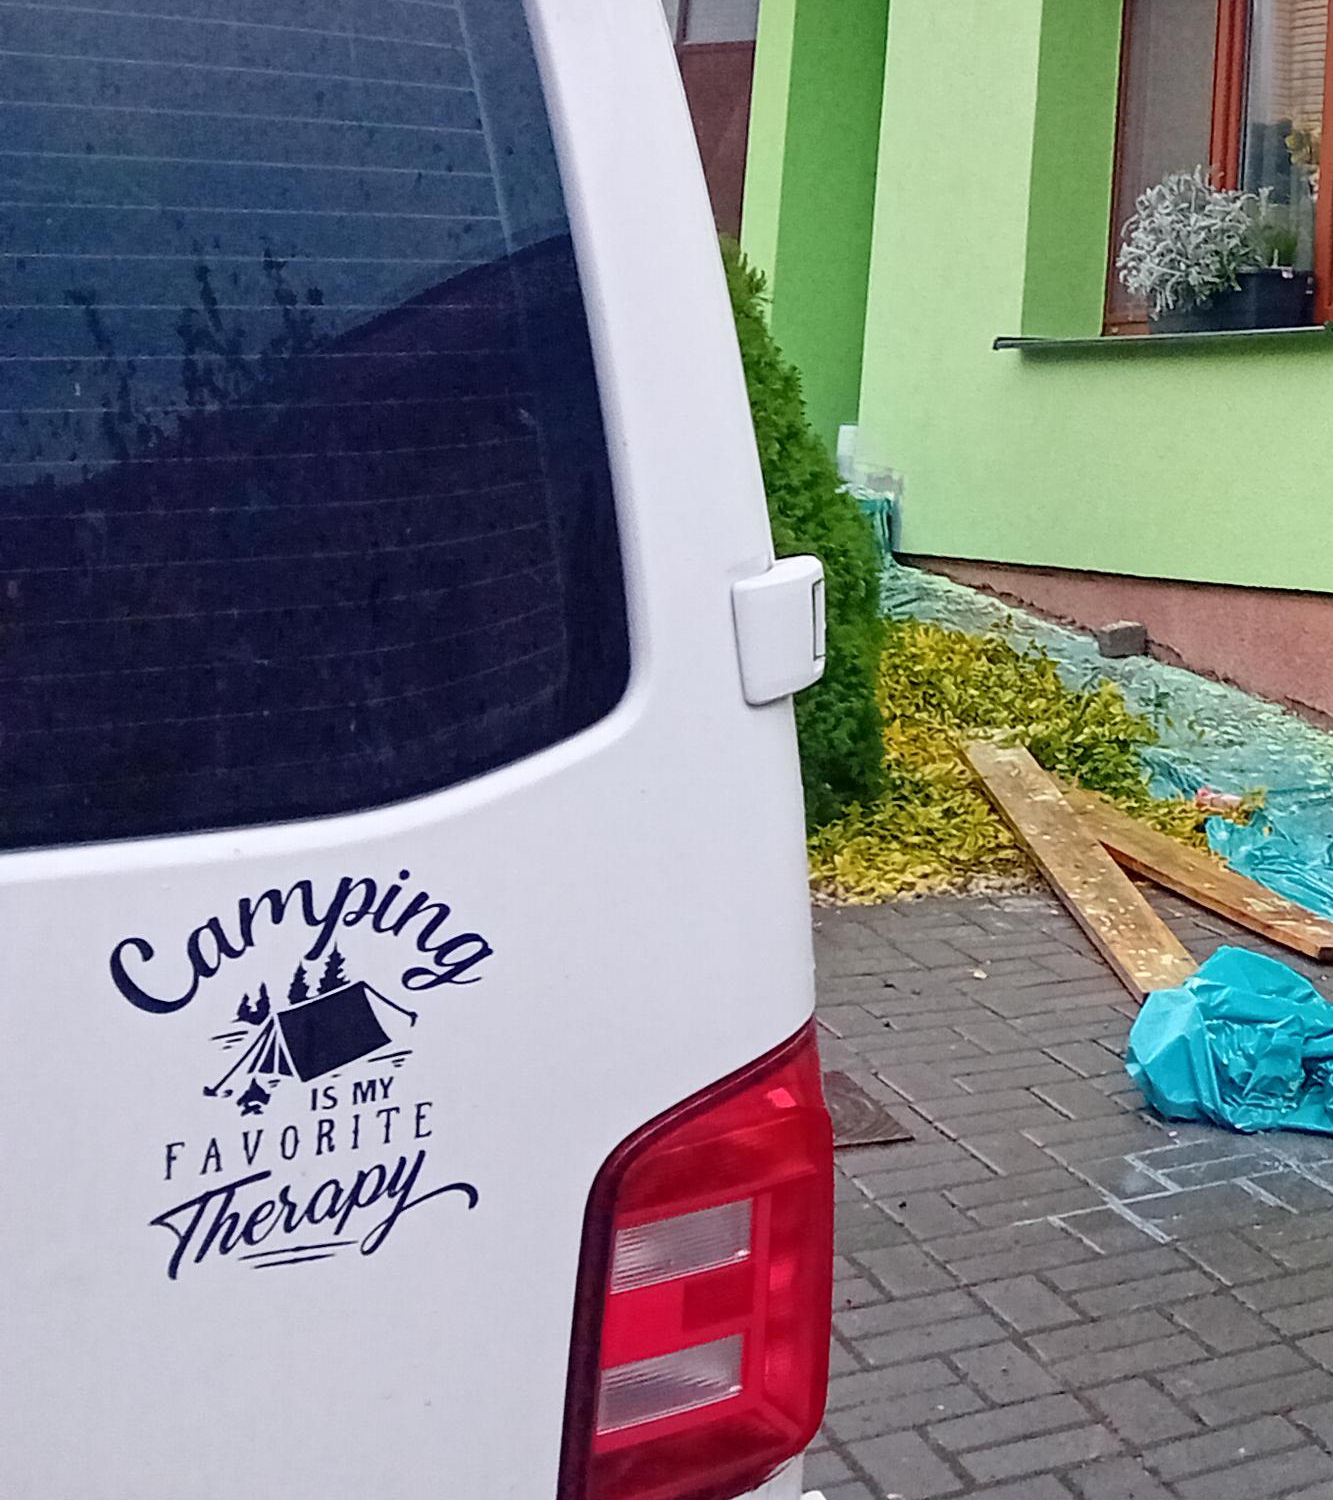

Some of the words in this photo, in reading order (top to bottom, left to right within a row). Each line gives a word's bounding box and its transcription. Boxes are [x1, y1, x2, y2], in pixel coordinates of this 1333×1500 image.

[109, 868, 494, 1015] Camping
[164, 1101, 433, 1181] FAVORITE
[310, 1085, 338, 1112] IS
[352, 1075, 394, 1106] MY
[149, 1149, 479, 1281] Therapy
